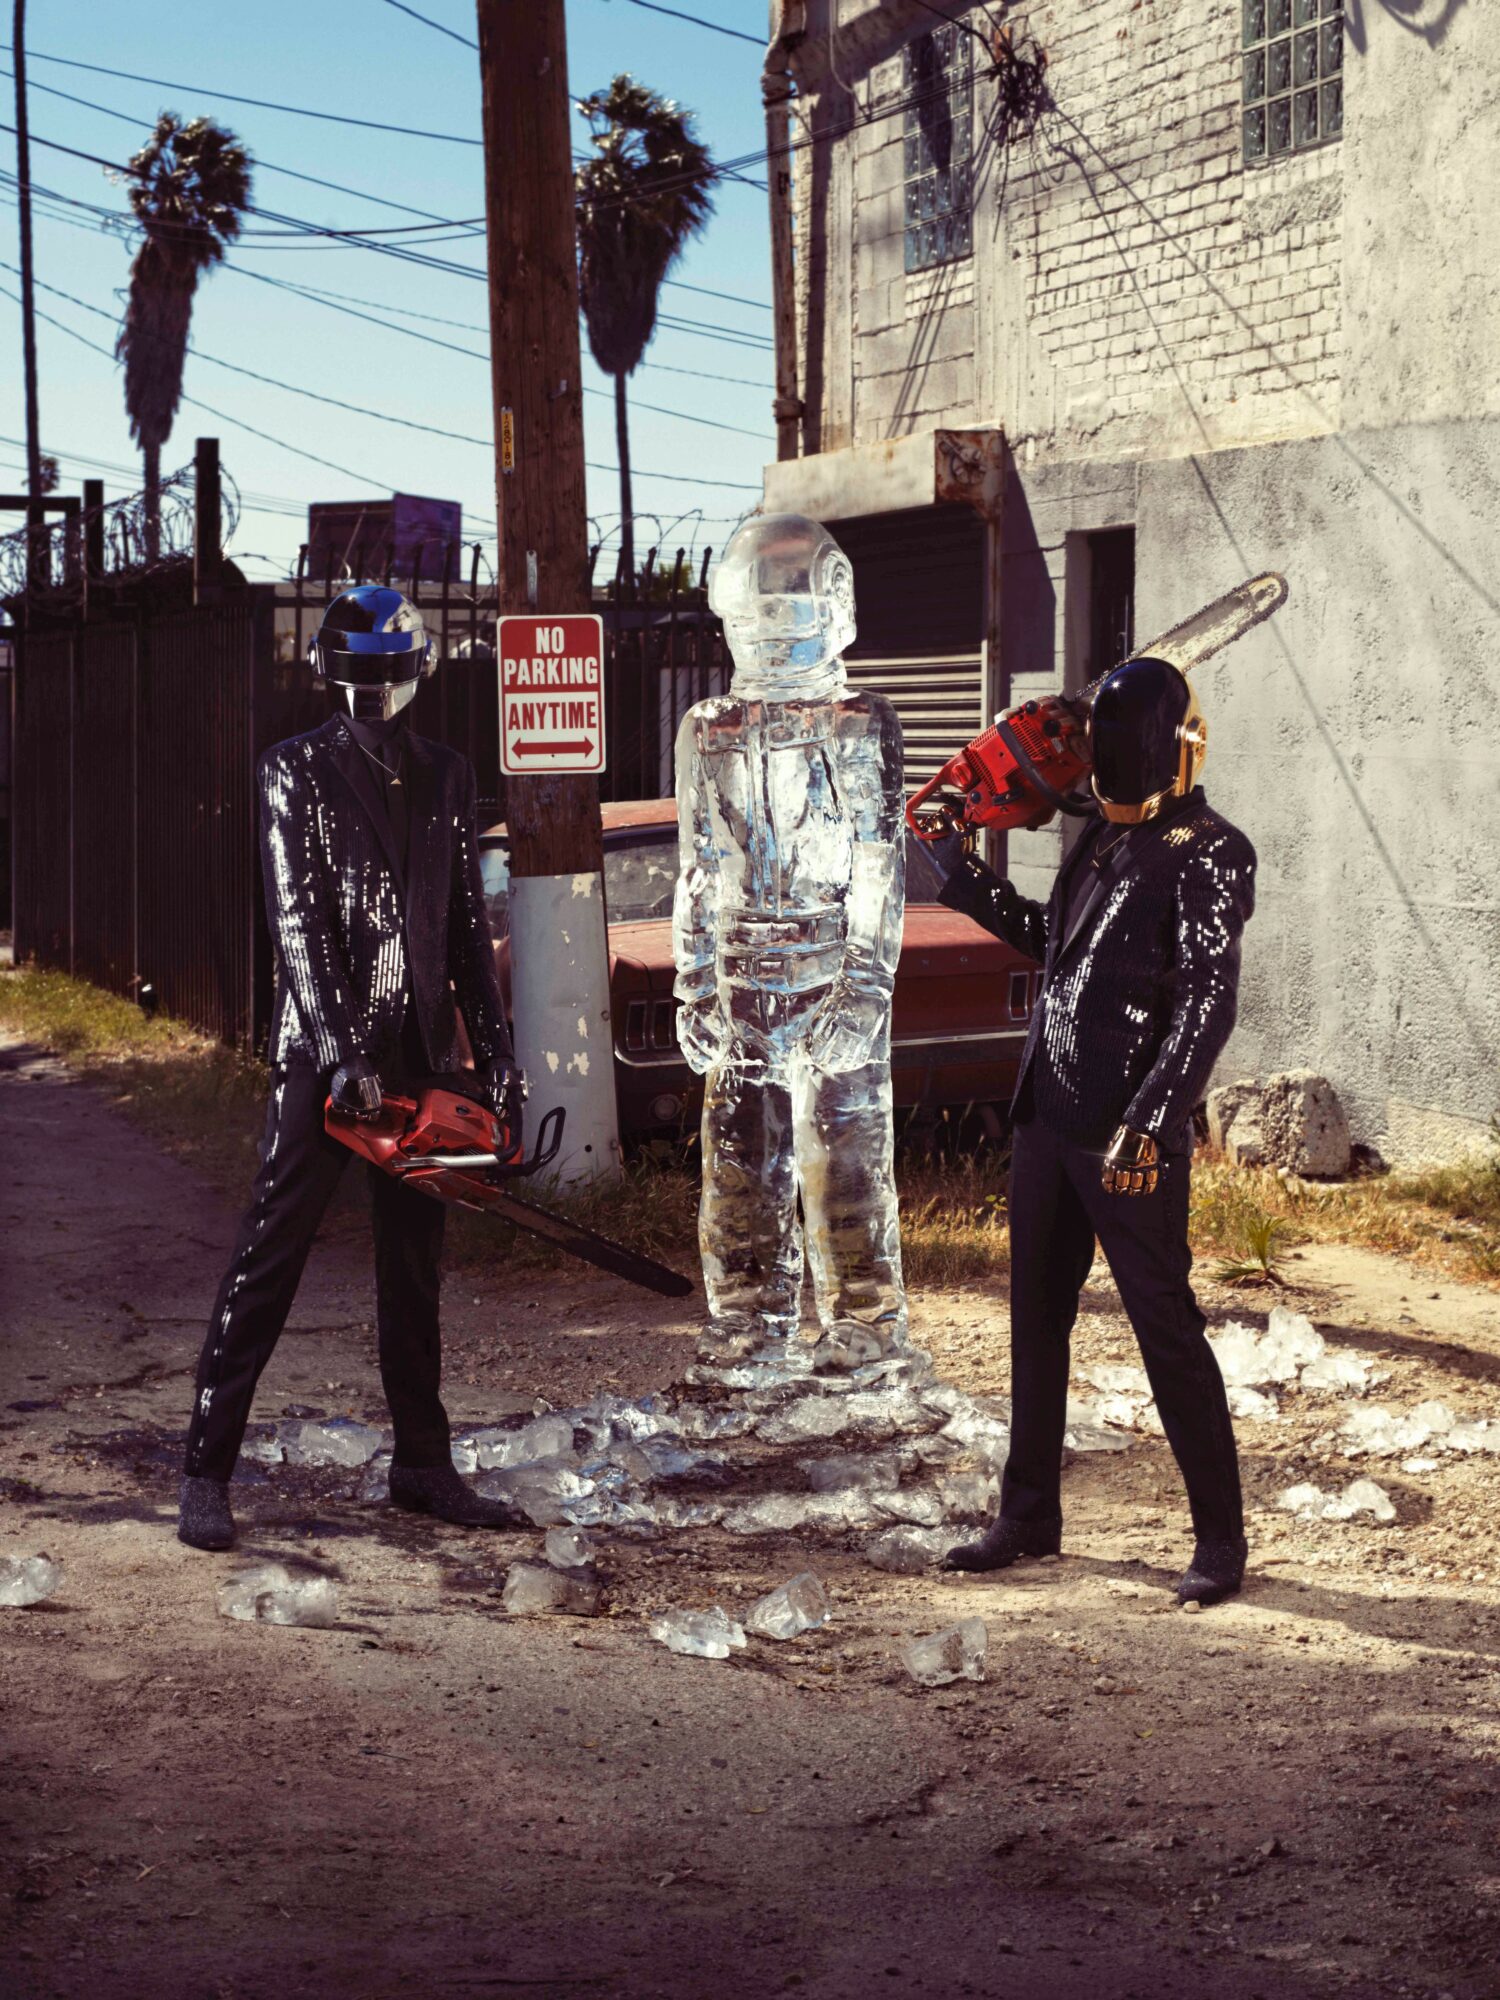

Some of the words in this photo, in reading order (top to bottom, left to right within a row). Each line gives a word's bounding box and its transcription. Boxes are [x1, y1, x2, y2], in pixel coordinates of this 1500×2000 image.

[536, 626, 565, 654] NO
[504, 657, 598, 685] PARKING
[508, 702, 597, 730] ANYTIME
